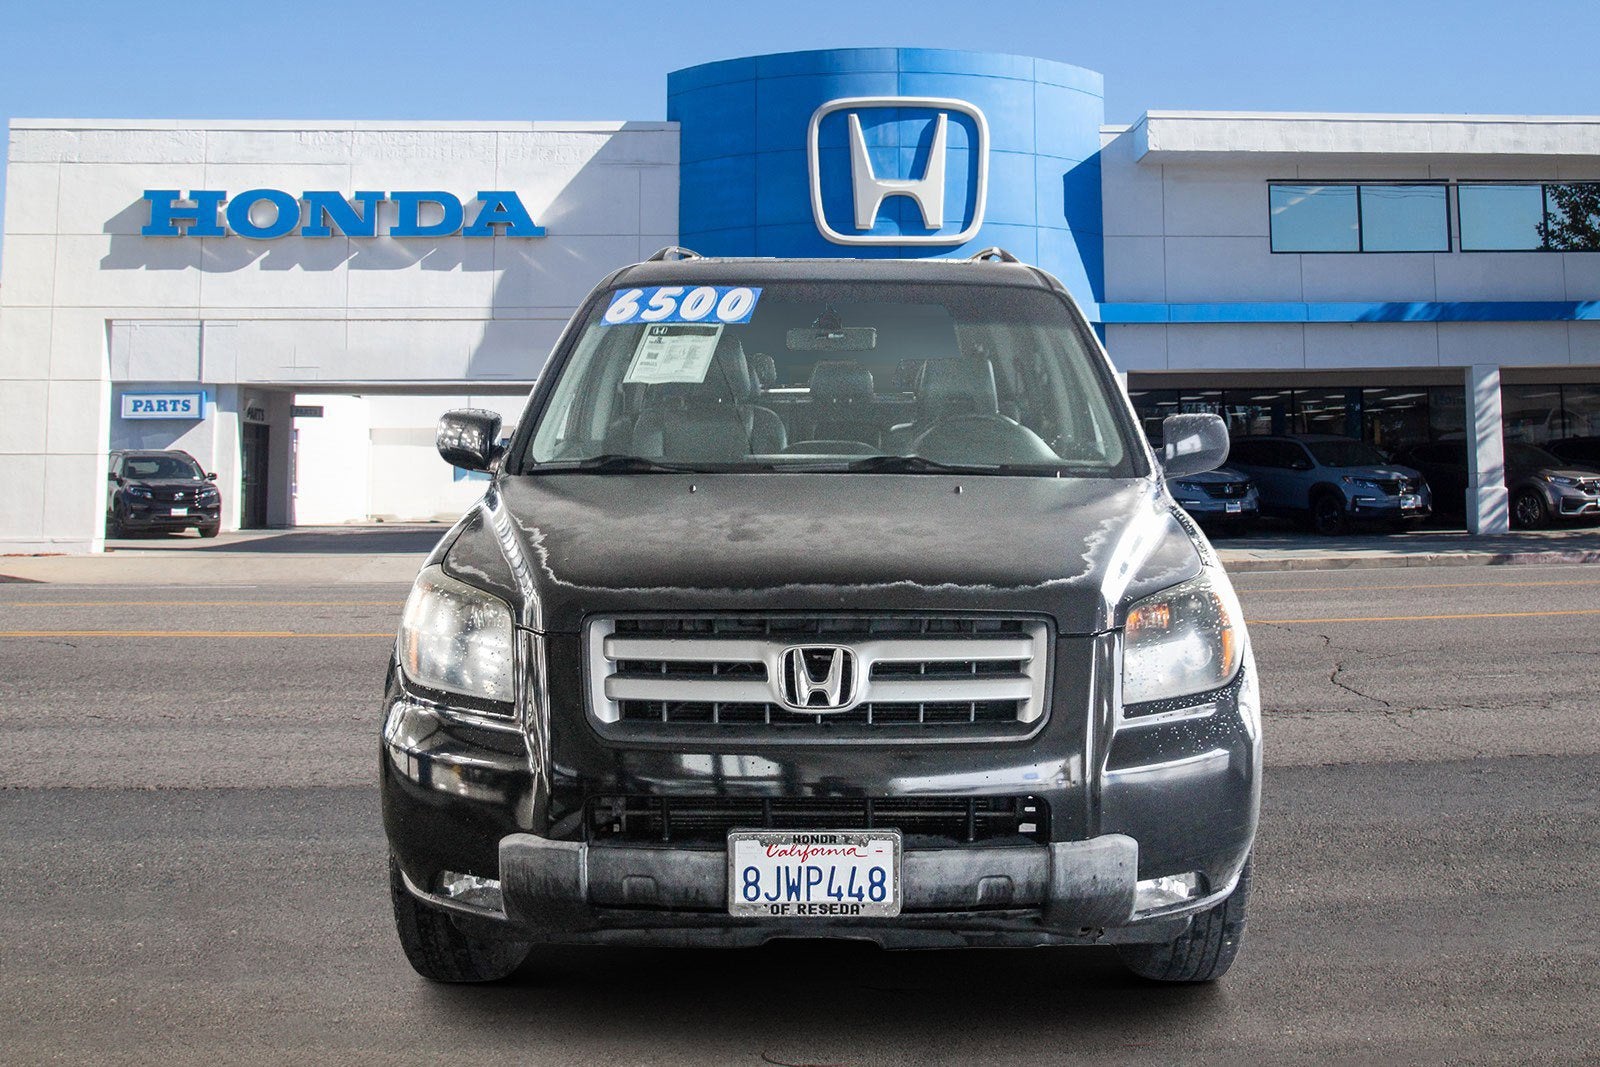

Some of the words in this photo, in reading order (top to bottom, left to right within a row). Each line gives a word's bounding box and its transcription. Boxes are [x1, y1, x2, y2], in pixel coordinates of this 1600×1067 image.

[142, 189, 547, 239] HONDA
[604, 286, 756, 323] 6500
[132, 399, 192, 413] PARTS
[792, 834, 838, 844] HONDA
[766, 844, 868, 863] California
[742, 865, 887, 902] 8JWP448
